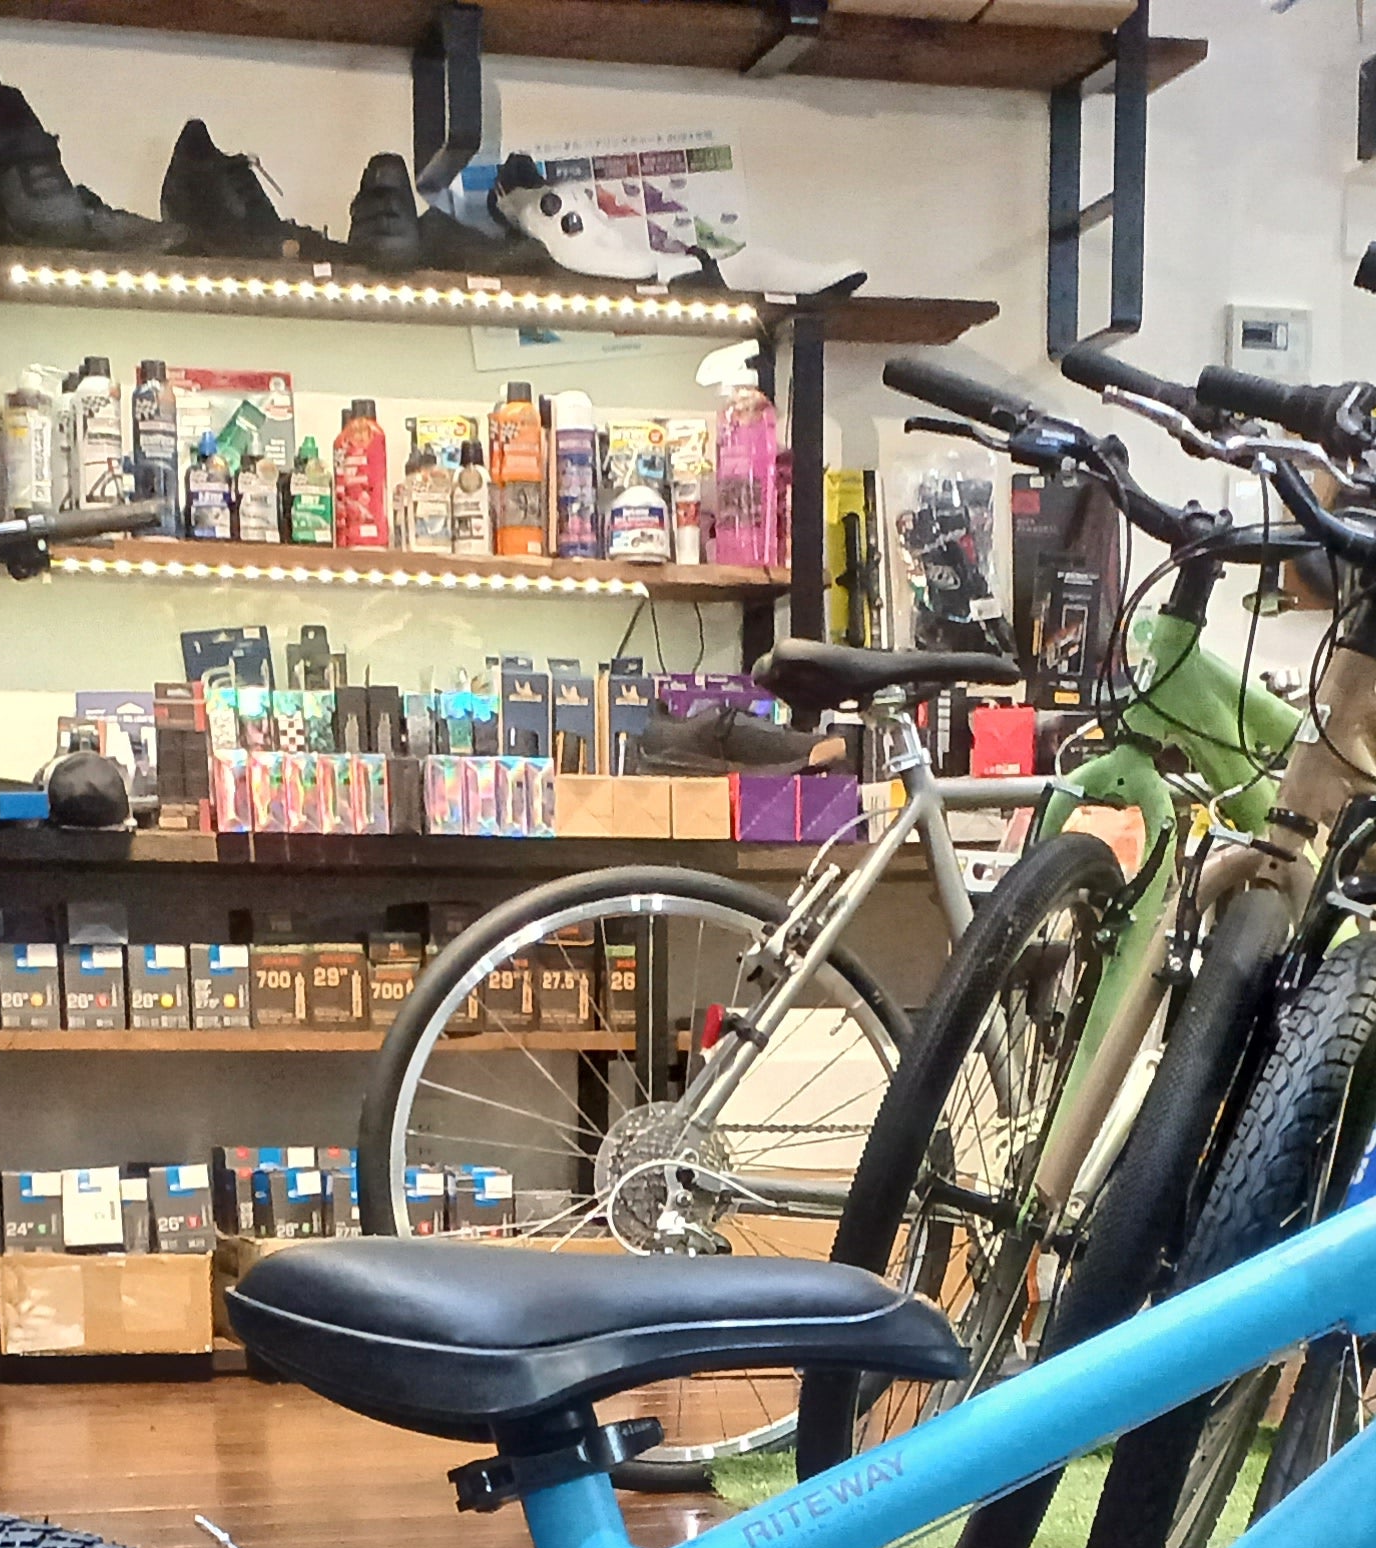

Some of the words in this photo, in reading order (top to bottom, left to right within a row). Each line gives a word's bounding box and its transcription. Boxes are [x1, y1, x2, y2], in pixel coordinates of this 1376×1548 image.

[256, 970, 292, 989] 700
[314, 967, 348, 987] 29"
[371, 983, 404, 999] 700
[6, 1221, 34, 1237] 24"
